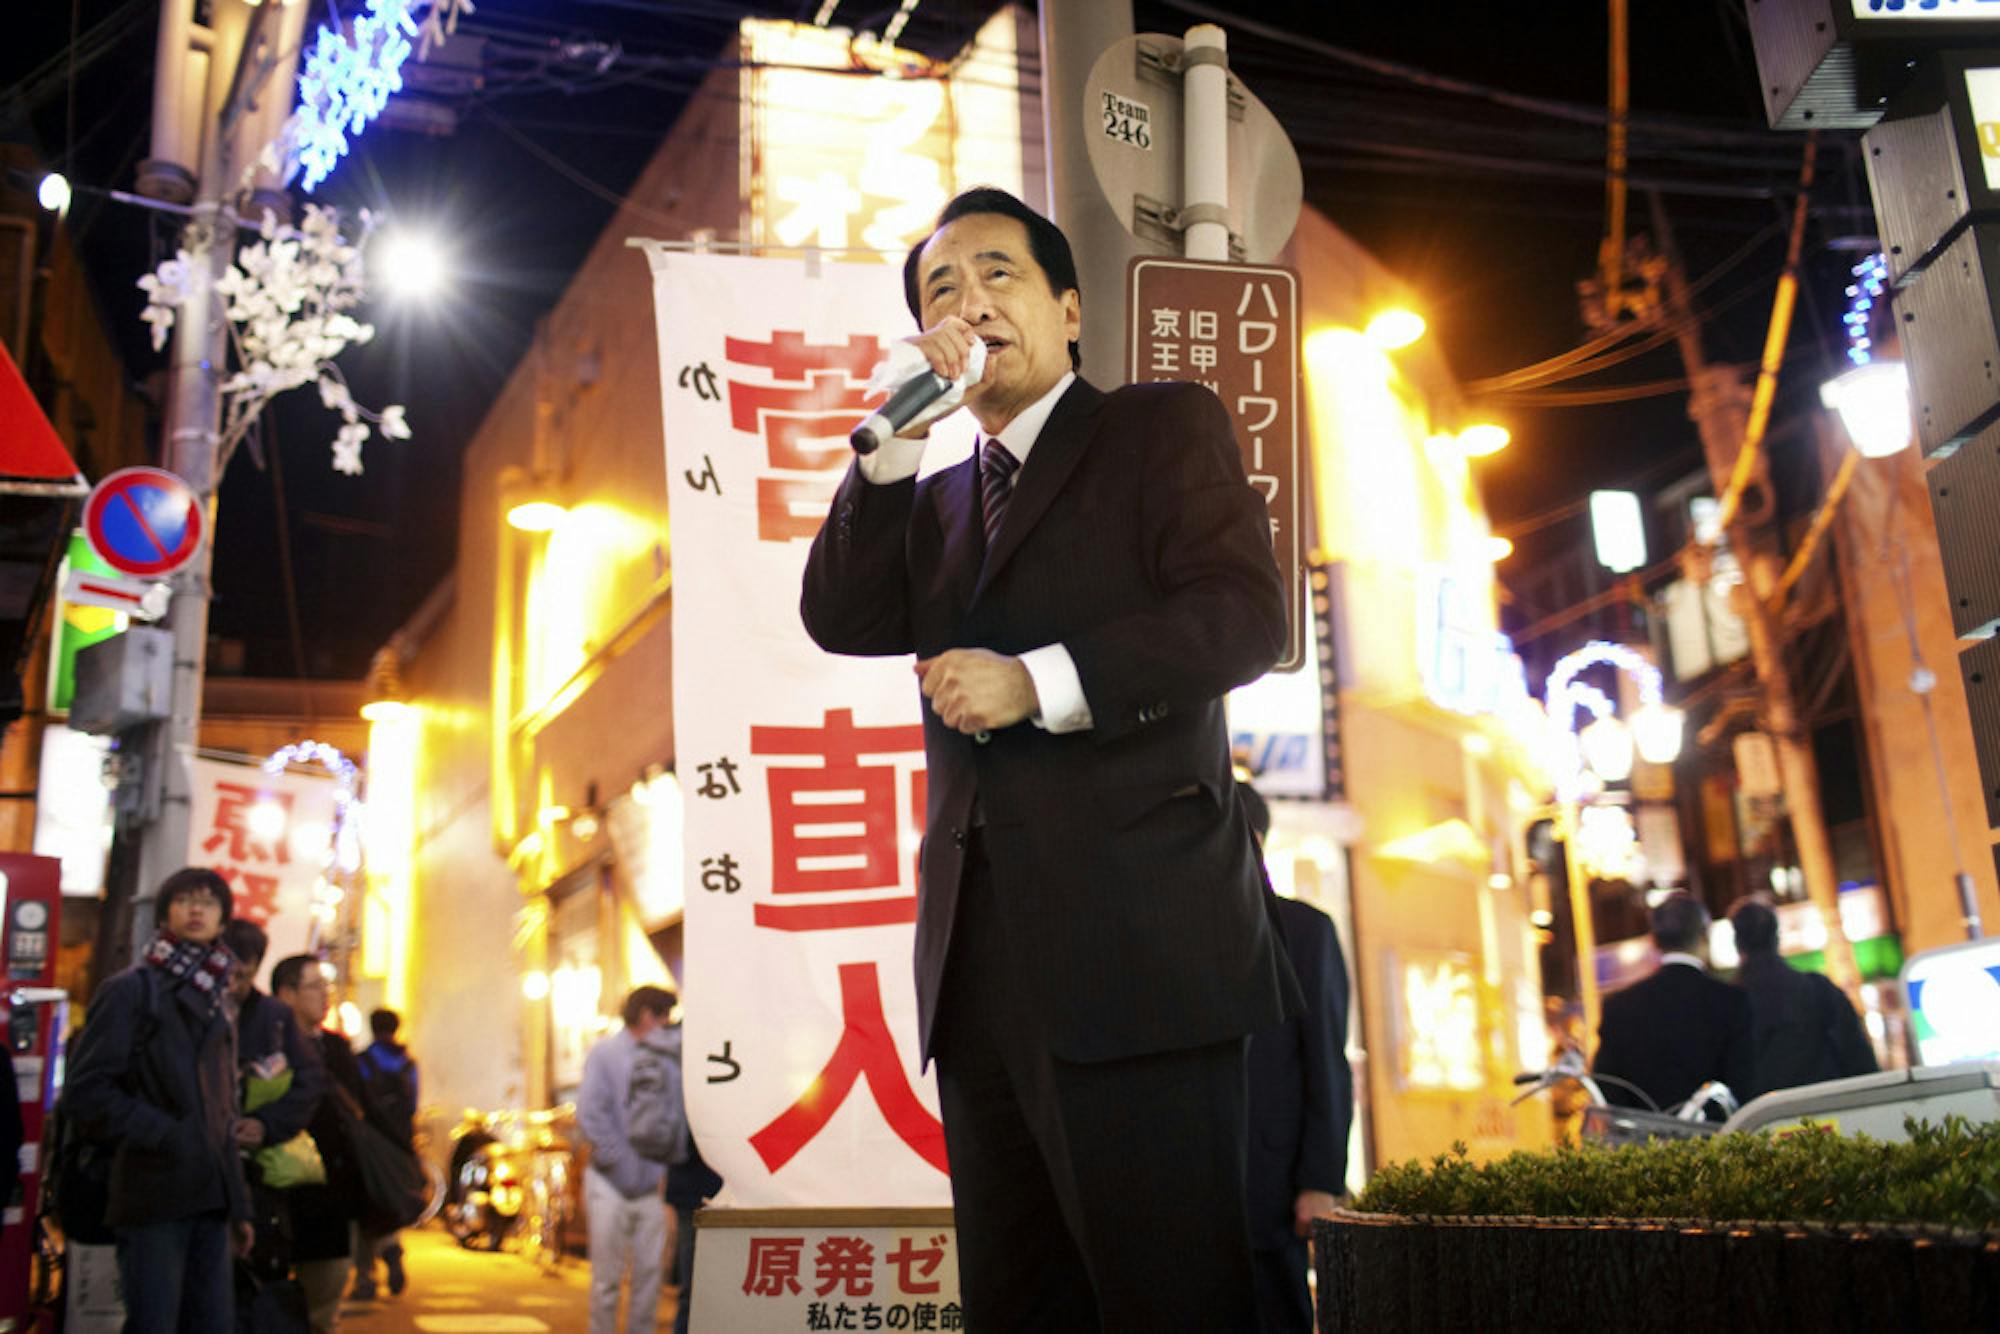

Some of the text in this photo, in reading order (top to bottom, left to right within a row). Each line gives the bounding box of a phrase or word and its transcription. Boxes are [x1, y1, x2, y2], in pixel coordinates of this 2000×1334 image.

[1103, 91, 1149, 122] Team
[1103, 111, 1150, 149] 246
[1150, 308, 1181, 383] 京王
[1237, 282, 1279, 550] ハローワー
[742, 1234, 948, 1298] 原発ゼ
[806, 1302, 963, 1332] 私たちの使命
